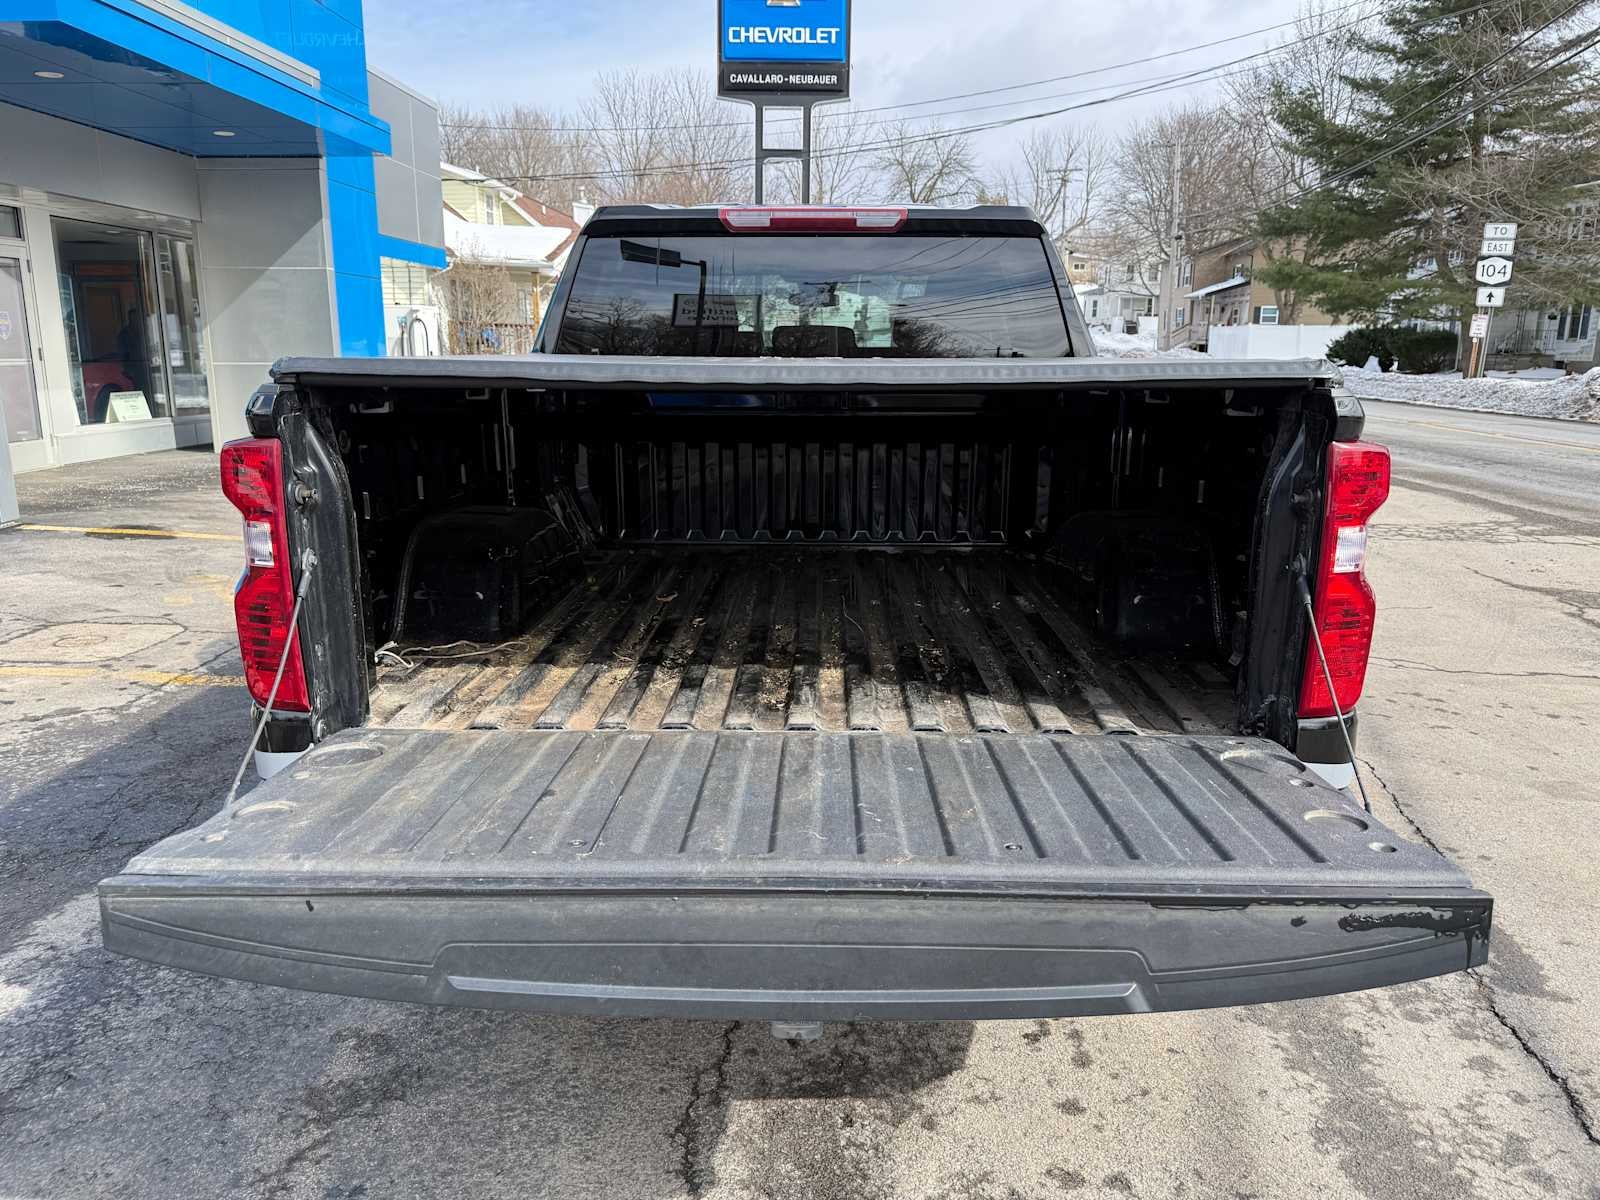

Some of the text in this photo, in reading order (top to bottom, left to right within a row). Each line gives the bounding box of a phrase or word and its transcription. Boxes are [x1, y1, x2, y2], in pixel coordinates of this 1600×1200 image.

[728, 27, 840, 44] CHEVROLET
[730, 74, 838, 84] CAVALLARO-NEUBAUER
[1494, 226, 1508, 235] TO
[1487, 243, 1508, 252] EAST
[1481, 264, 1507, 277] 104
